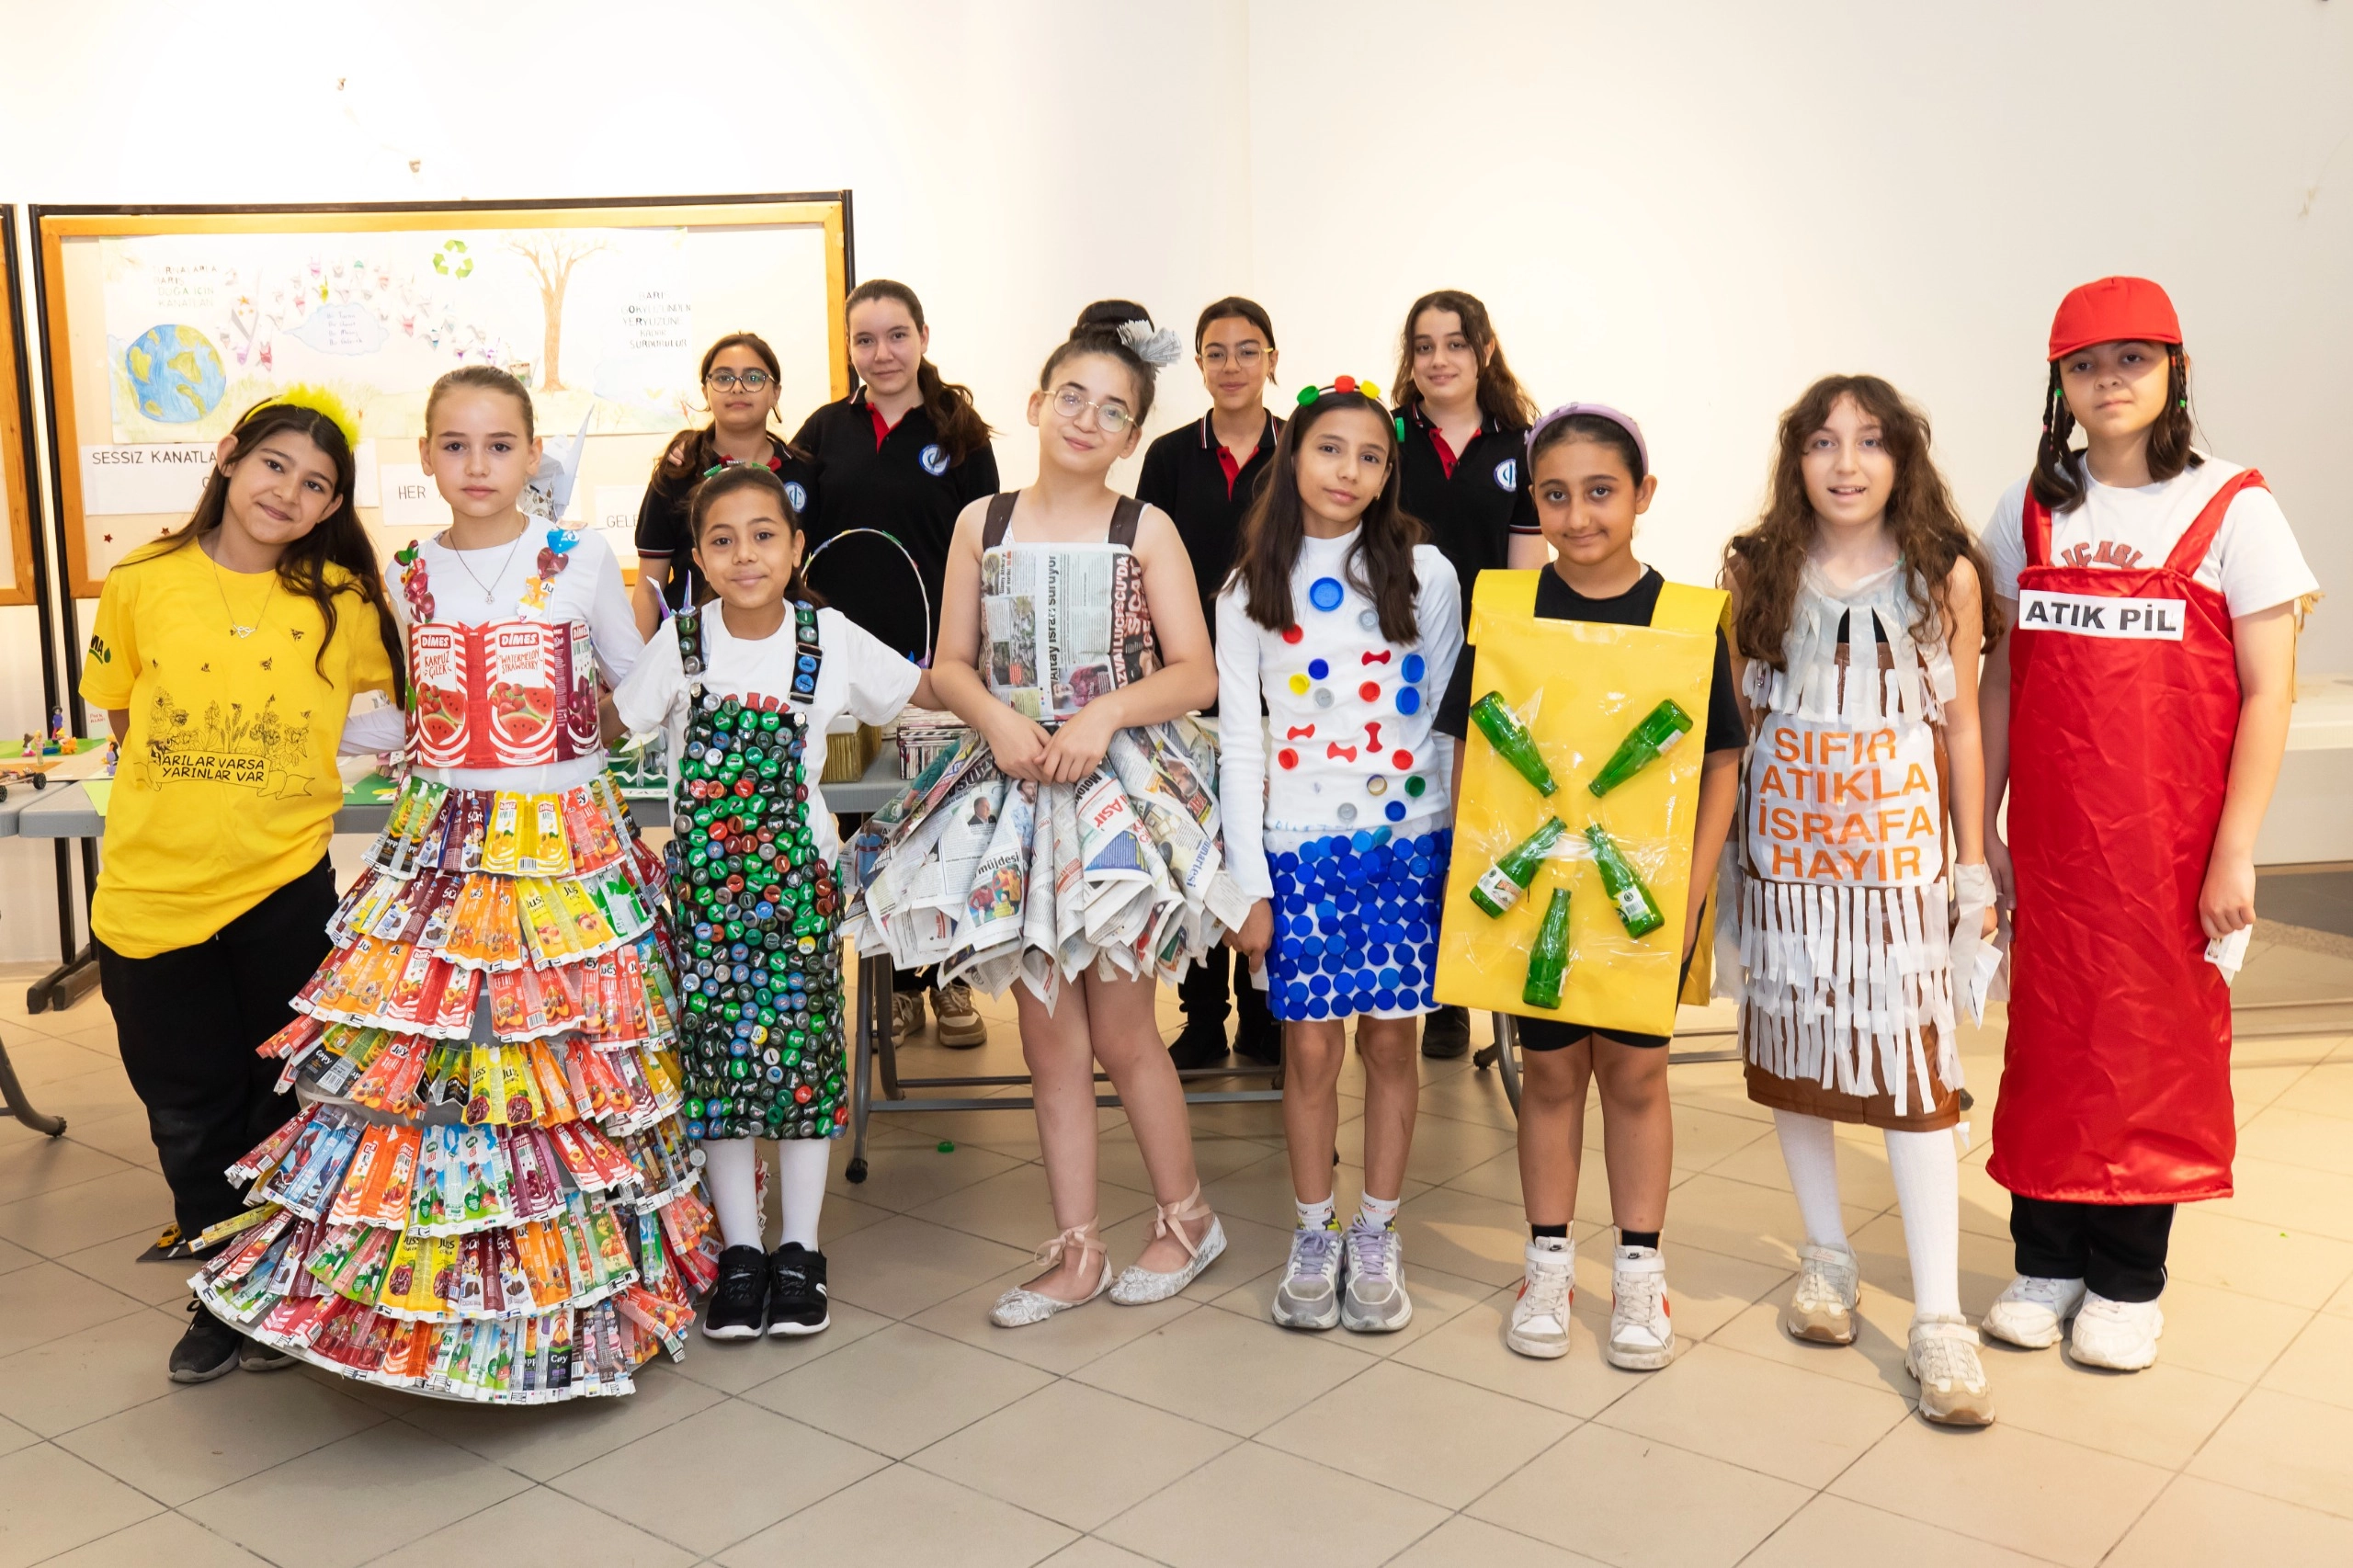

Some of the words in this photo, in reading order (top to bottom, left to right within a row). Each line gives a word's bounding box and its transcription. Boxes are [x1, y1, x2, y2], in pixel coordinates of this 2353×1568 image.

[398, 484, 426, 500] HER
[2025, 600, 2106, 630] ATIK
[2119, 603, 2177, 632] PİL
[424, 650, 450, 668] KARPUZ
[1773, 727, 1897, 766] SIFIR
[162, 754, 216, 767] ARILAR
[217, 757, 265, 770] VARSA
[162, 767, 231, 781] YARINLAR
[235, 770, 265, 782] VAR
[1758, 762, 1931, 804] ATIKLA
[977, 851, 1020, 873] müjdesi
[1771, 843, 1922, 881] HAYIR
